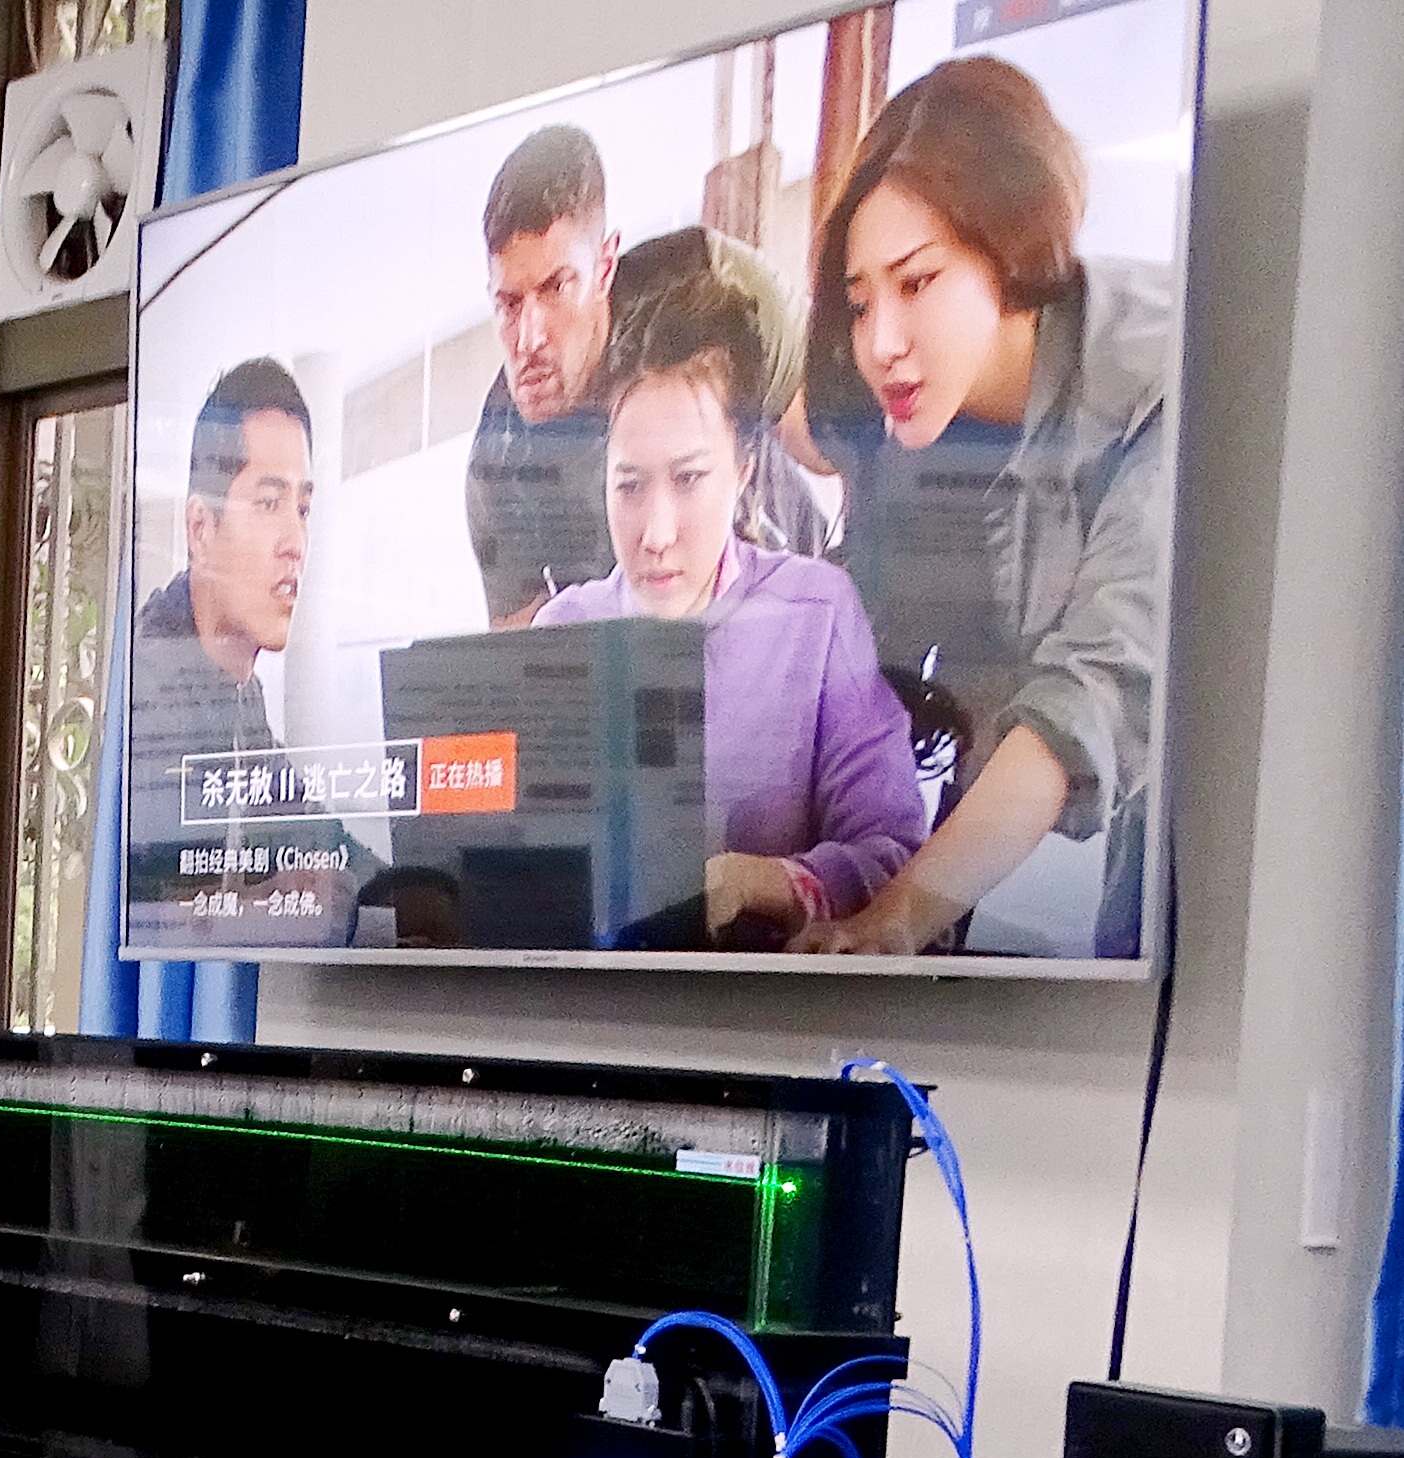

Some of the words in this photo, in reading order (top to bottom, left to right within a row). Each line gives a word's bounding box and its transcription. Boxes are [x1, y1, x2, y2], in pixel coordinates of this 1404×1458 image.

[201, 766, 273, 807] 杀无赦
[302, 757, 407, 803] 逃亡之路
[429, 758, 504, 790] 正在热播
